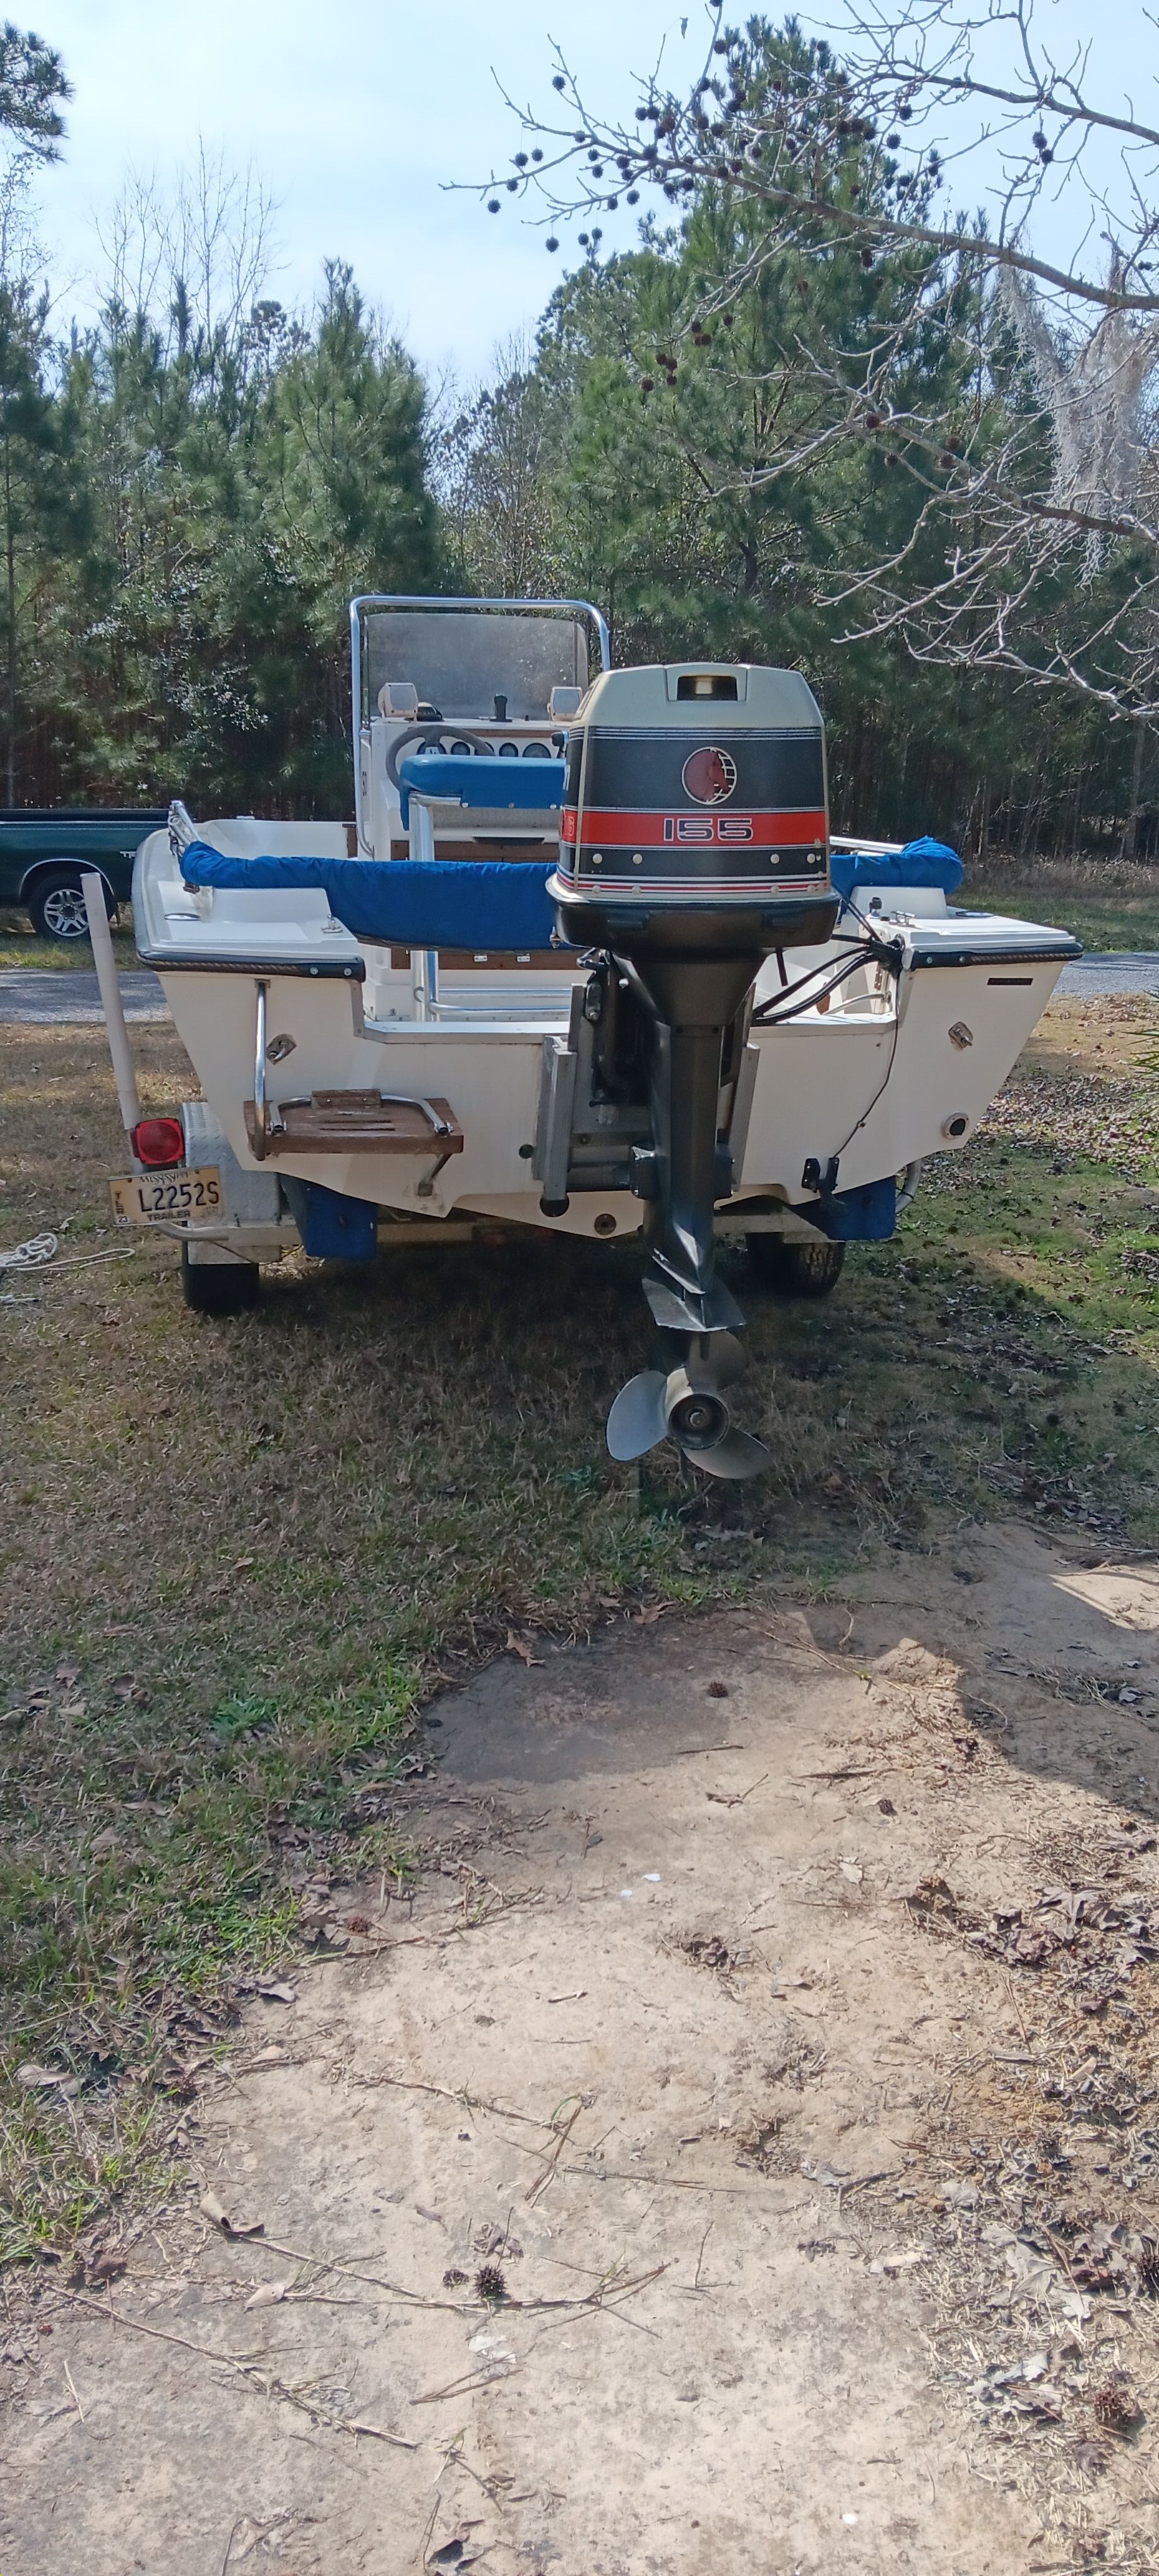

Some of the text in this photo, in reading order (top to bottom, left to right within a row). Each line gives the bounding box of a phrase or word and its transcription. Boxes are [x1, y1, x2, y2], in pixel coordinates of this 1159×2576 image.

[663, 818, 753, 841] 155
[138, 1181, 219, 1212] L2252S
[146, 1210, 191, 1221] TRAILER
